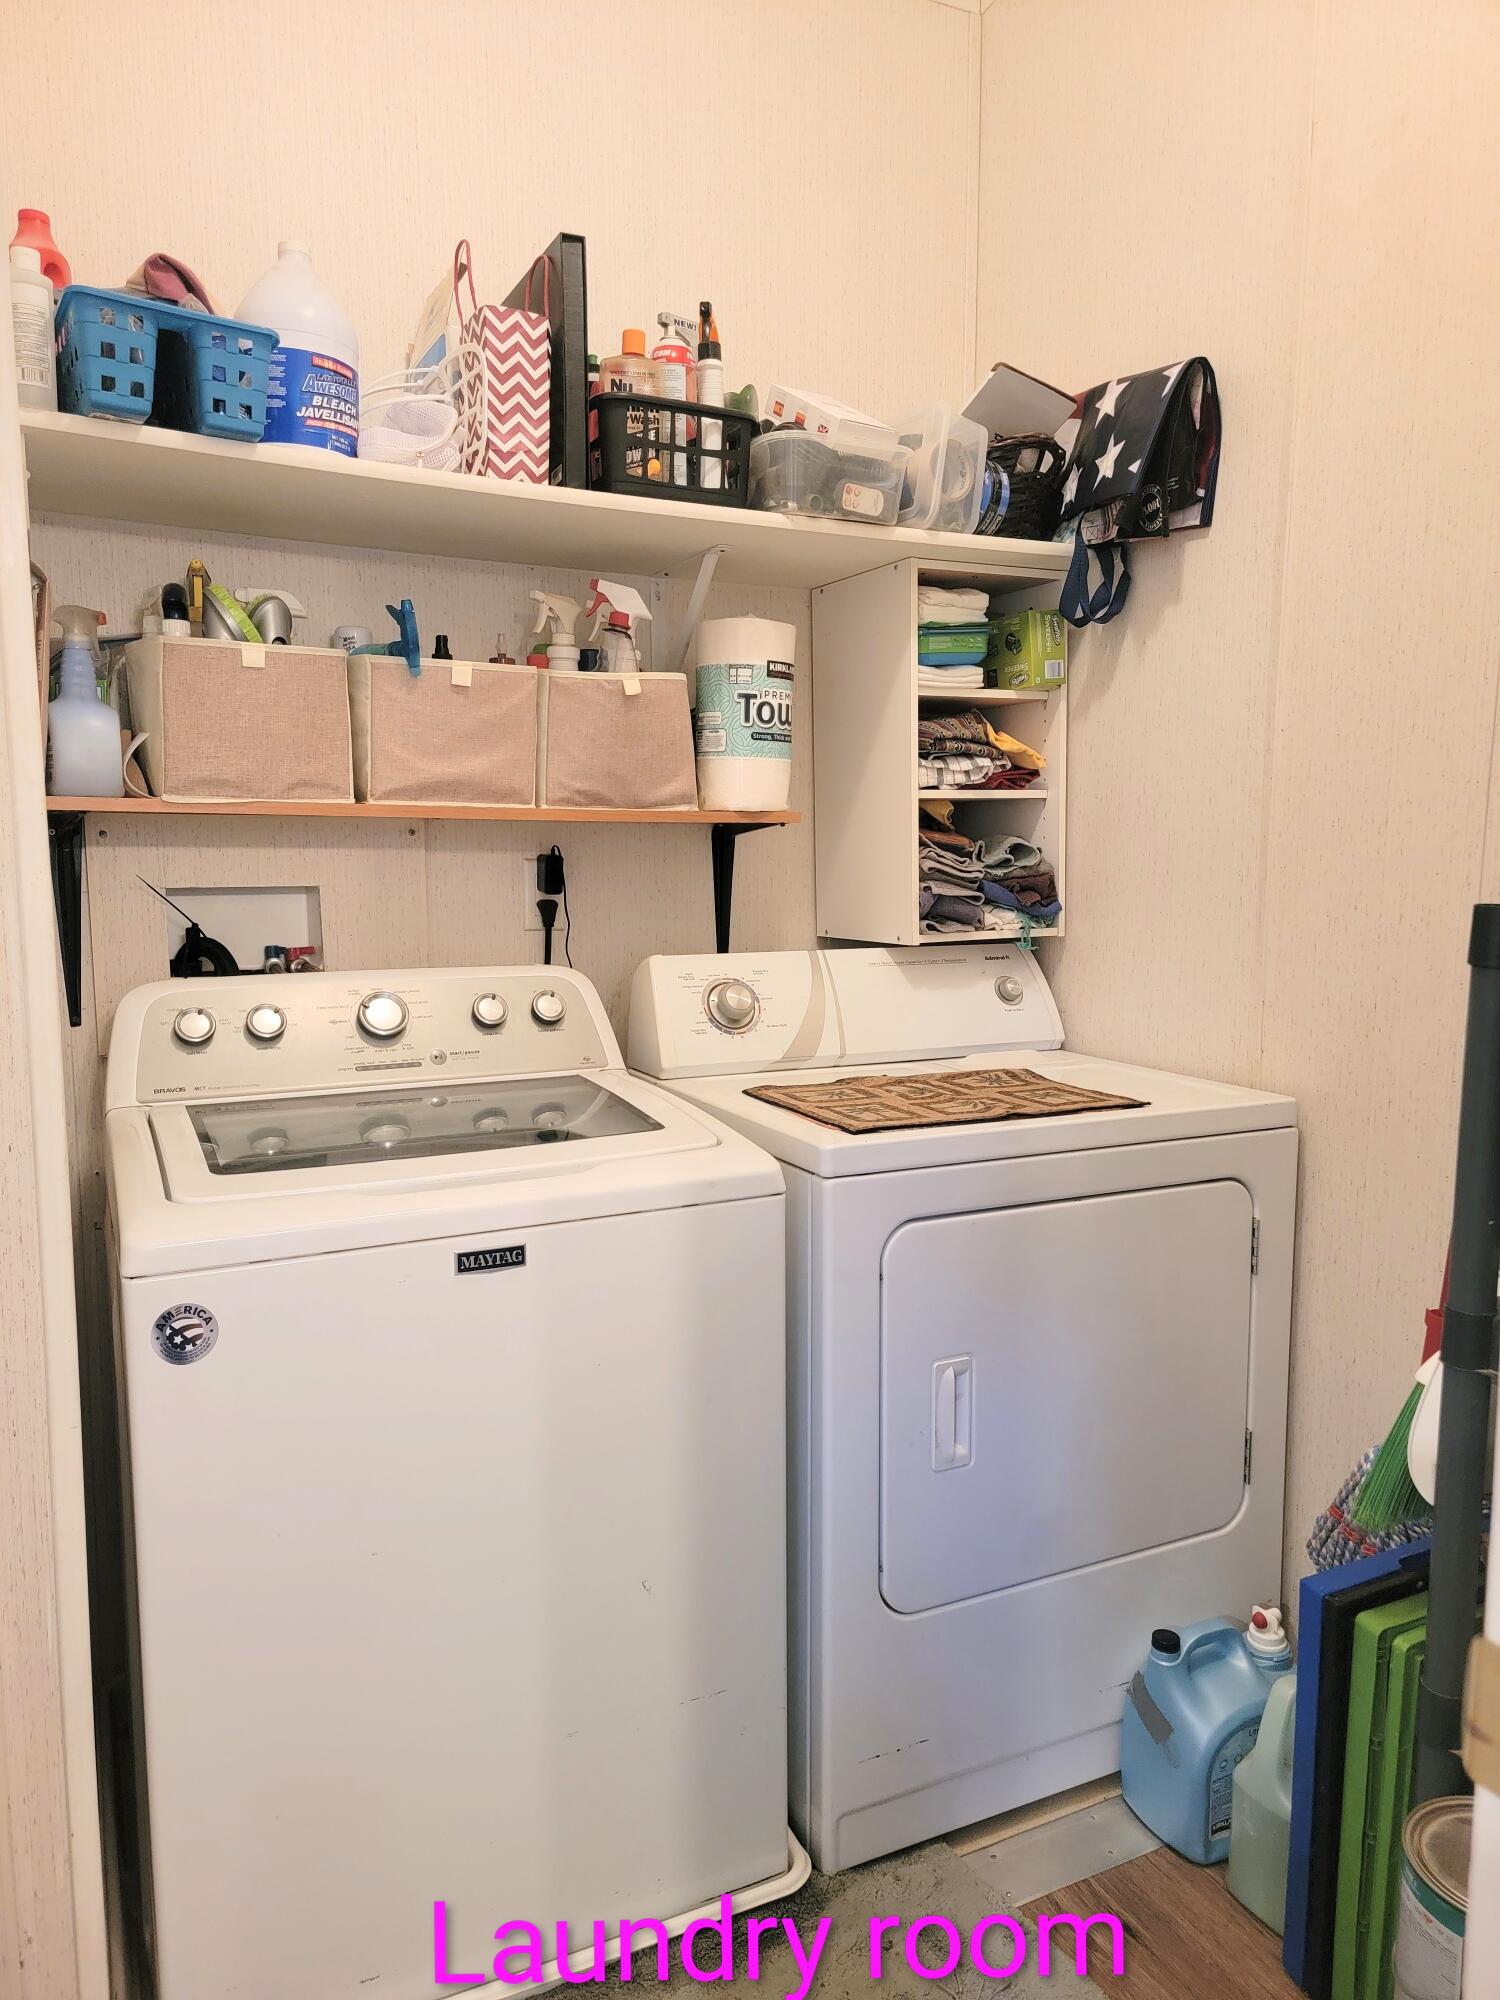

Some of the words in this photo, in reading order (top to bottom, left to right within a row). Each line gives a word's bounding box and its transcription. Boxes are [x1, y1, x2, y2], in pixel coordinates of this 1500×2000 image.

[673, 318, 697, 331] NEW!
[610, 378, 633, 393] Nu
[312, 395, 357, 416] BLEACH
[460, 1249, 522, 1270] MAYTAG
[156, 1305, 213, 1333] AMERICA
